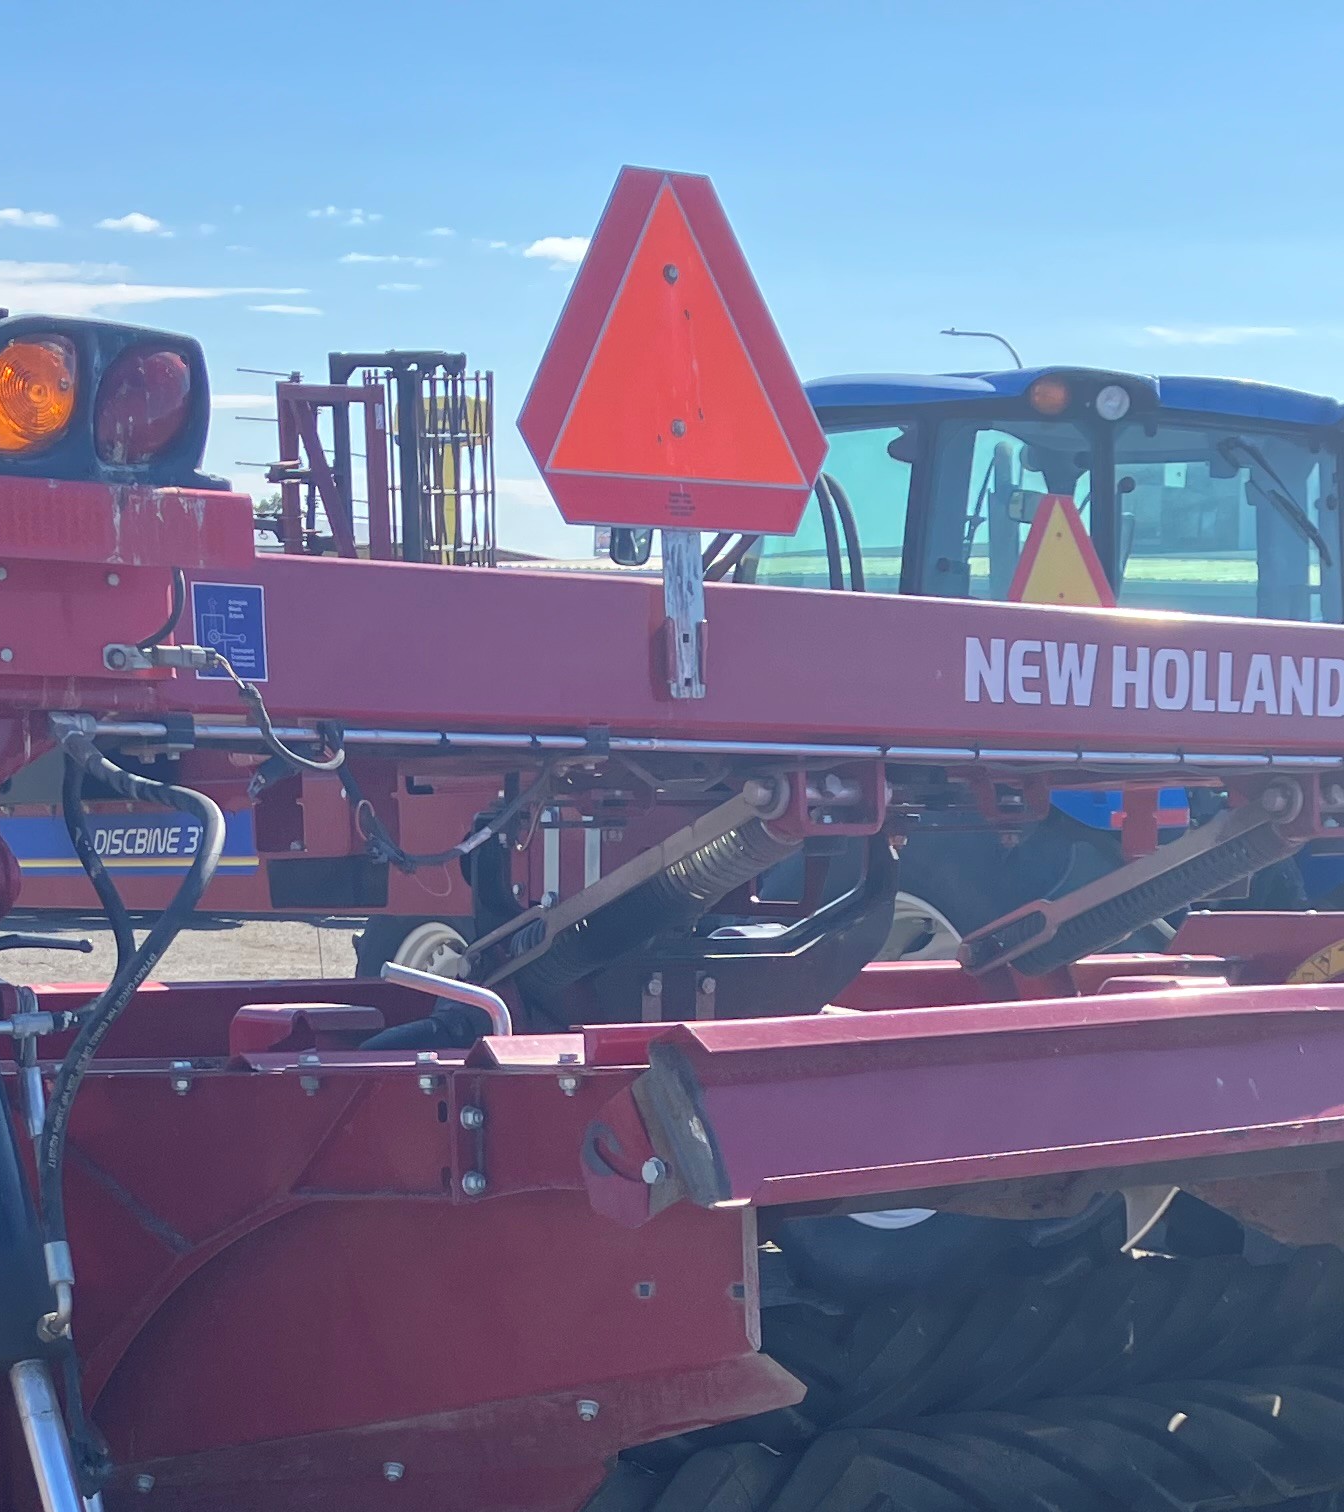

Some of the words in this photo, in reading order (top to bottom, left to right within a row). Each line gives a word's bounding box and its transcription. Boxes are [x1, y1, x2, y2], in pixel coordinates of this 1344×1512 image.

[964, 636, 1099, 707] NEW
[94, 827, 182, 855] DISCBINE
[184, 826, 204, 853] 3
